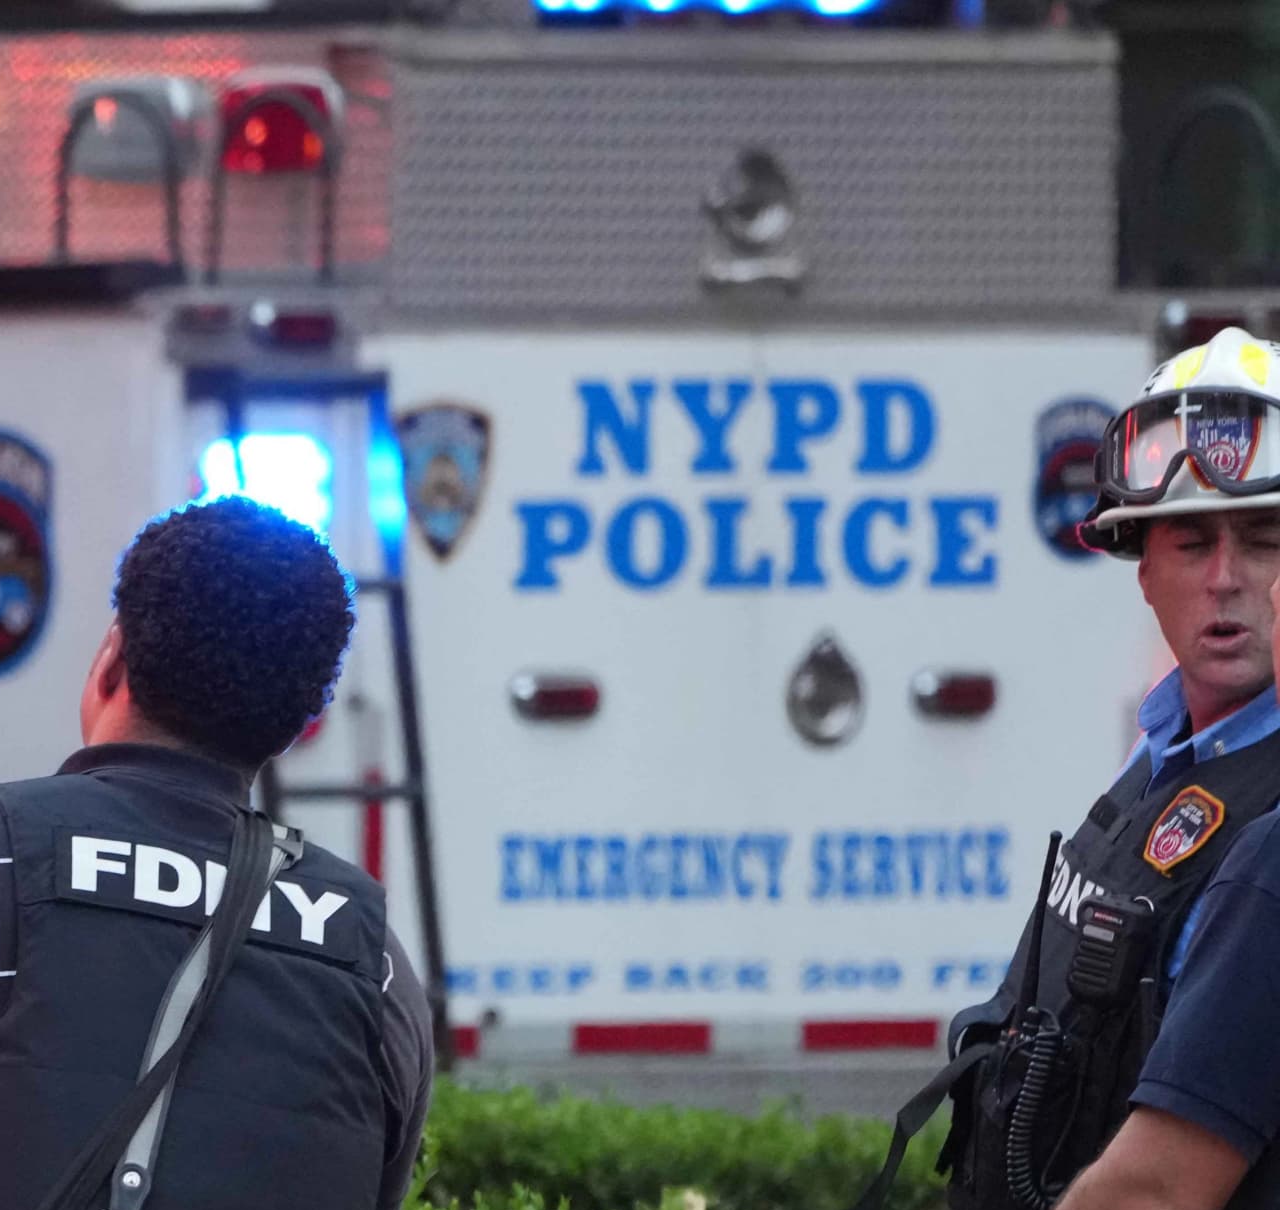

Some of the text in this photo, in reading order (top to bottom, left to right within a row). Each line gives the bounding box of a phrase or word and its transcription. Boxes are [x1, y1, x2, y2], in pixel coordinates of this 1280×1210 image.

[576, 379, 935, 474] NYPD
[514, 496, 1000, 589] POLICE
[502, 830, 1012, 900] EMERGENCY SERVICE
[1047, 842, 1105, 926] DN
[624, 962, 768, 991] BACK
[804, 962, 902, 990] 200
[930, 962, 1012, 990] FE
